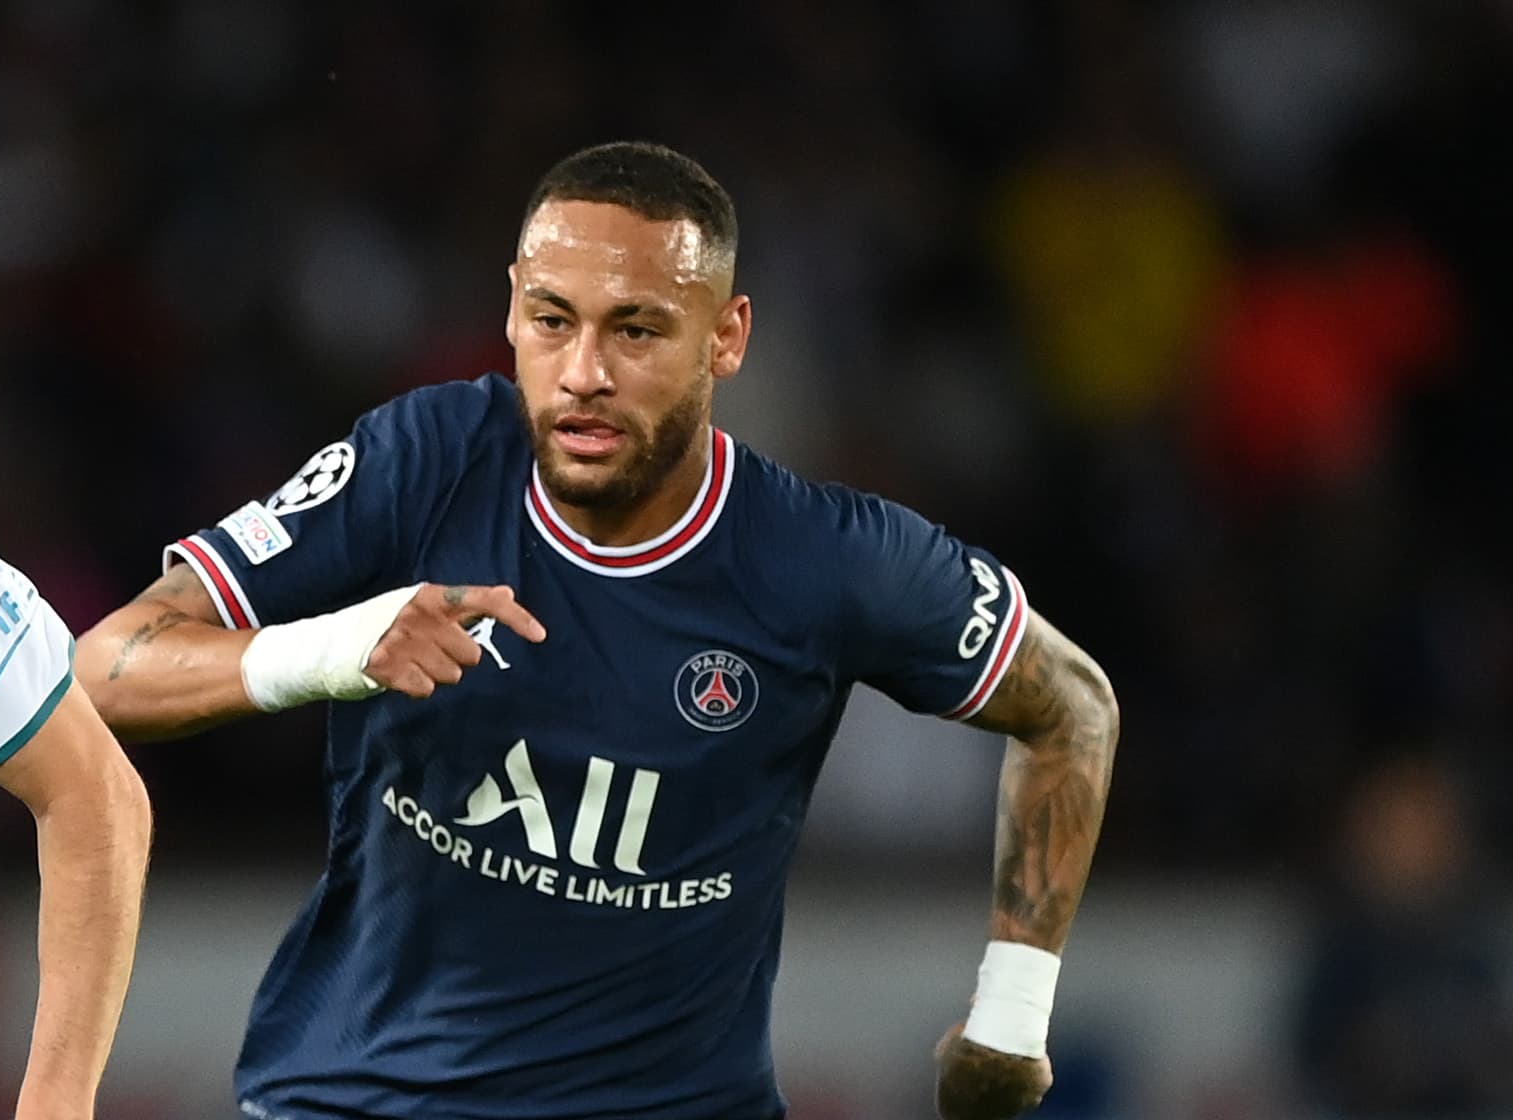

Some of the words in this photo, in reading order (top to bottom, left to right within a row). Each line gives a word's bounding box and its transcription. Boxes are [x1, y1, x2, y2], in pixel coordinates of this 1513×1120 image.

[958, 557, 1000, 659] QNB
[690, 655, 746, 677] PARIS
[382, 786, 473, 868] ACCOR
[481, 848, 559, 896] LIVE
[565, 872, 733, 909] LIMITLESS
